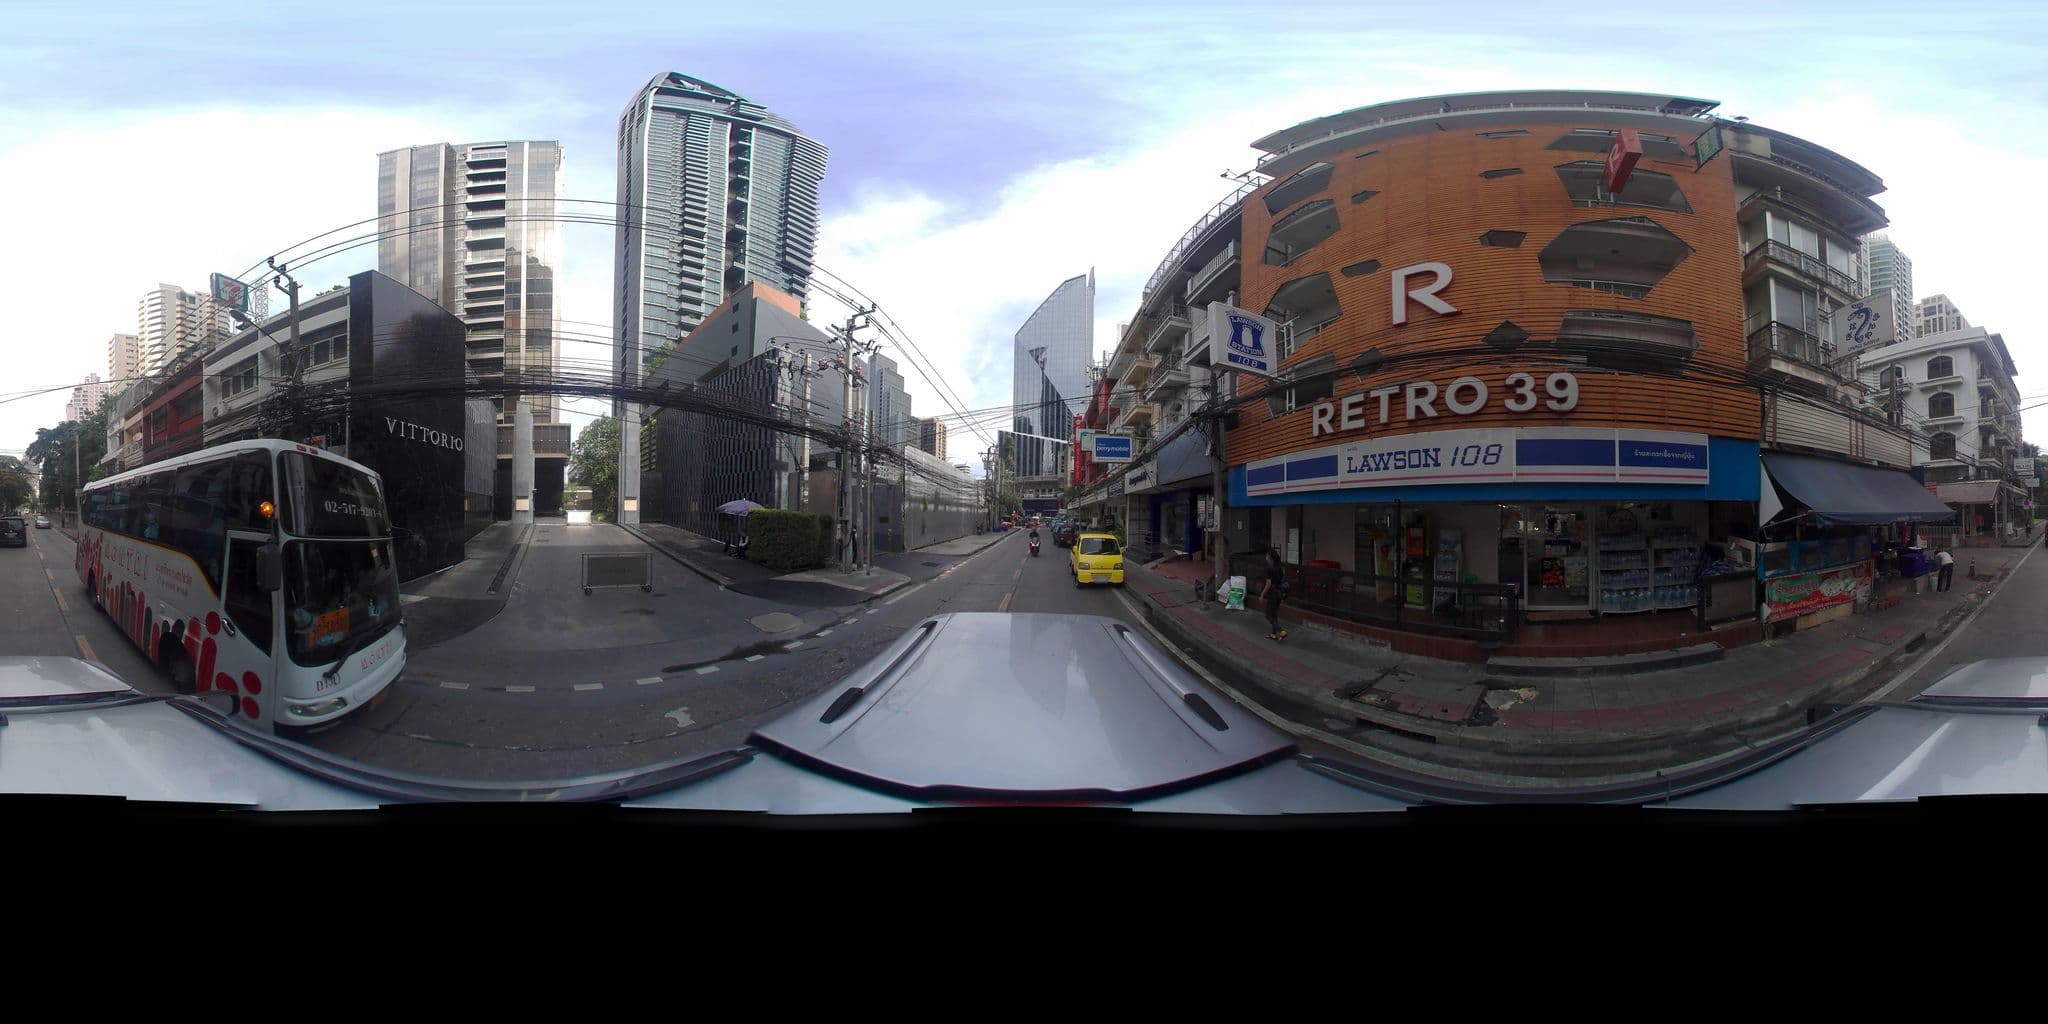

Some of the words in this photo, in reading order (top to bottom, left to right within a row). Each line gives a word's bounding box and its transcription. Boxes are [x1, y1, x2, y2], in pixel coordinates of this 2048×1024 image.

[1391, 261, 1460, 326] R
[1230, 341, 1264, 356] STATION
[1237, 356, 1258, 367] 108
[1312, 376, 1488, 437] RETRO
[1504, 372, 1579, 412] 39
[384, 416, 463, 451] VITTORIO
[1347, 448, 1441, 473] LAWSON
[1451, 444, 1503, 466] 108
